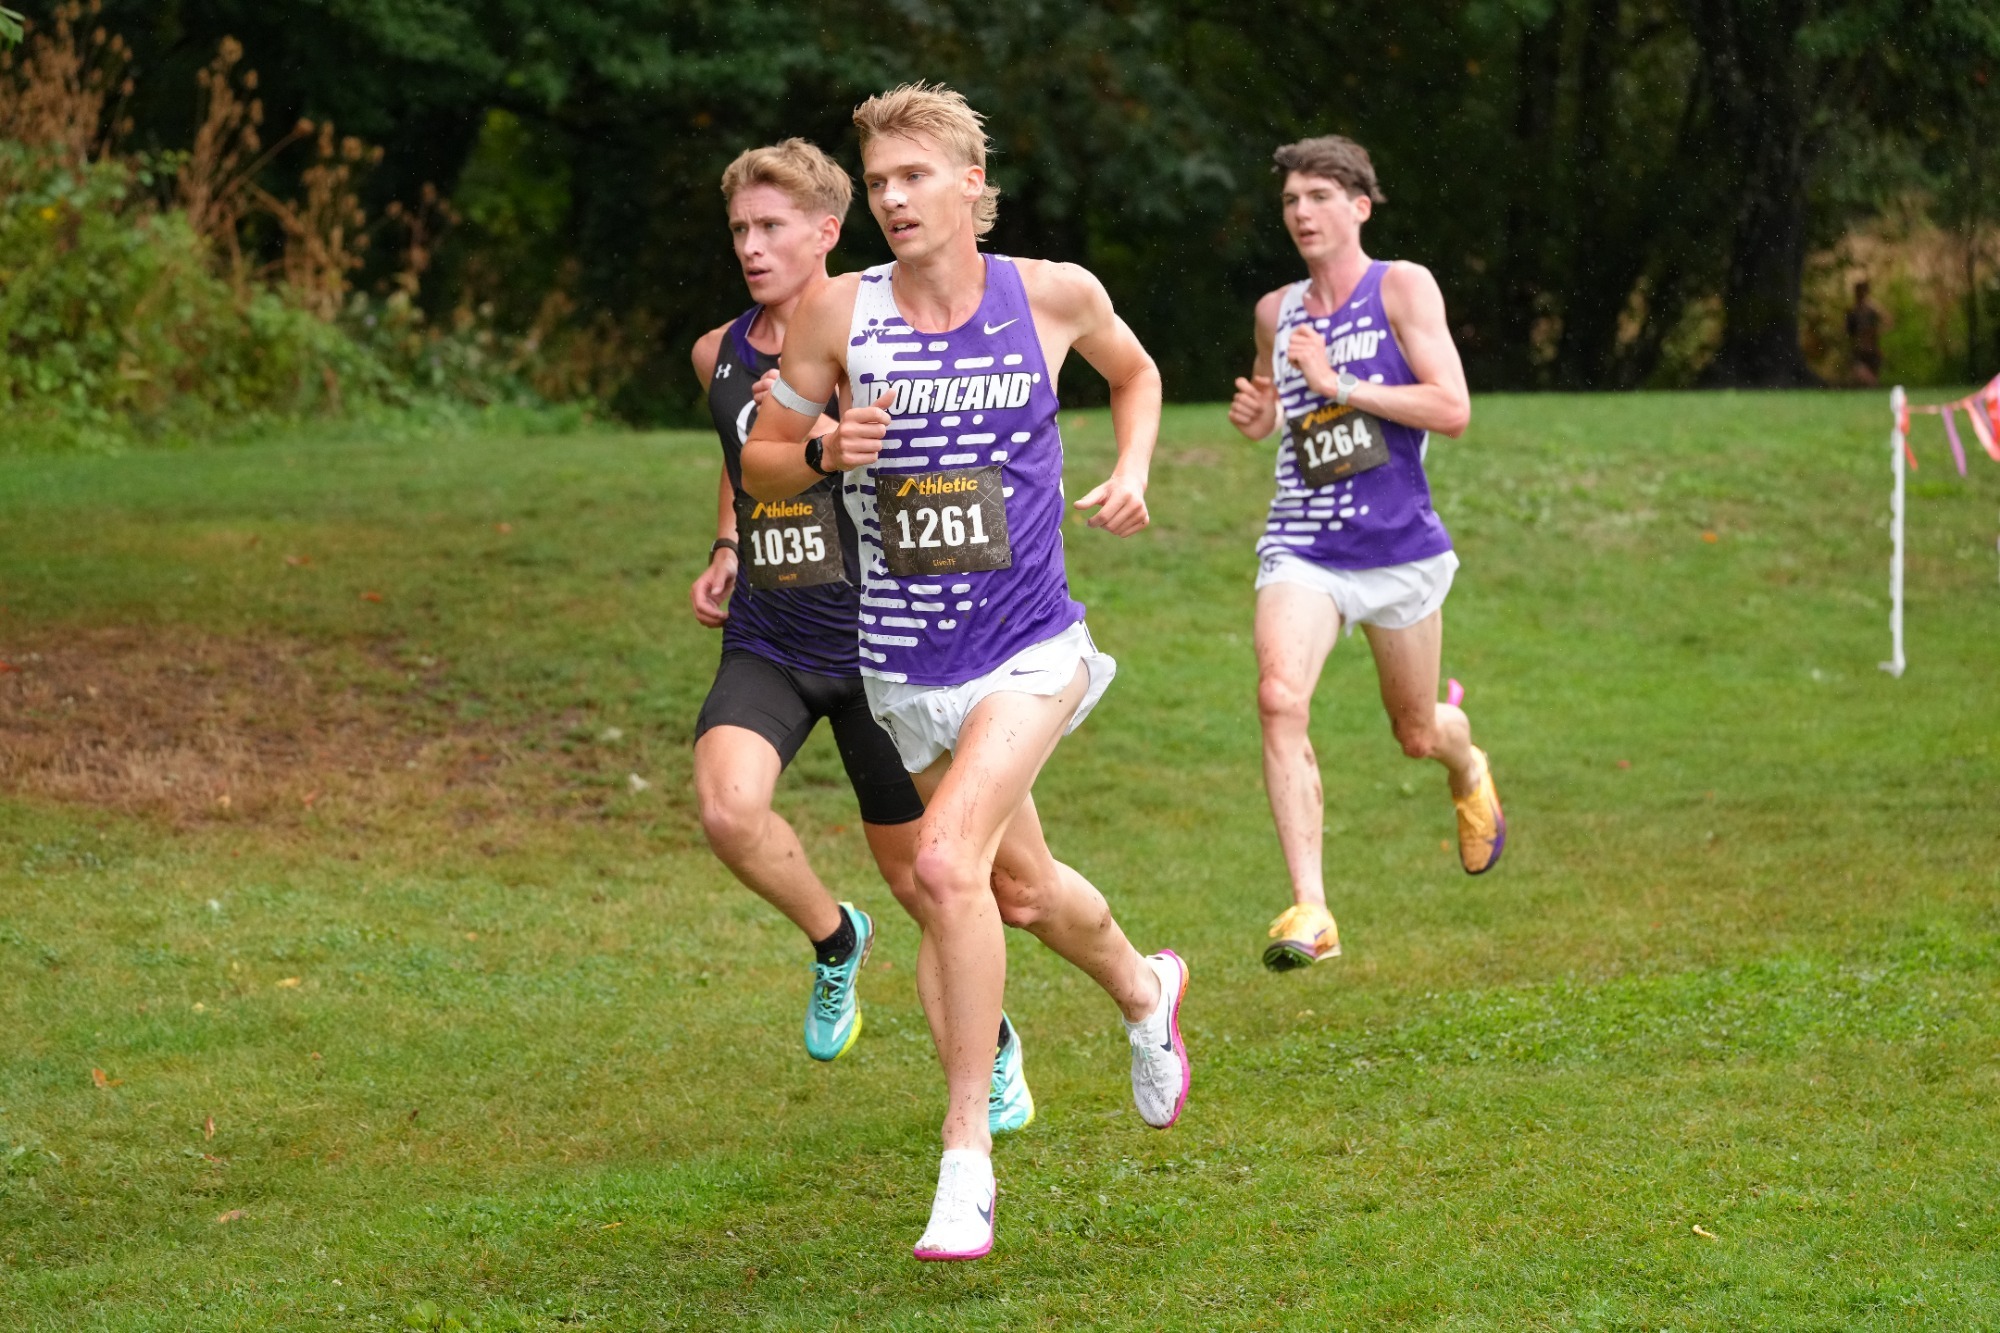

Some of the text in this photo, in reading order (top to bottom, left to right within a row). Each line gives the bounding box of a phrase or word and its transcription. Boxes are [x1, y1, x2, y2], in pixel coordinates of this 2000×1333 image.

[868, 371, 1033, 416] PORTLAND
[1303, 418, 1373, 469] 1264
[896, 475, 979, 497] Athletic
[751, 500, 814, 519] Athletic
[895, 503, 990, 549] 1261
[750, 525, 826, 566] 1035
